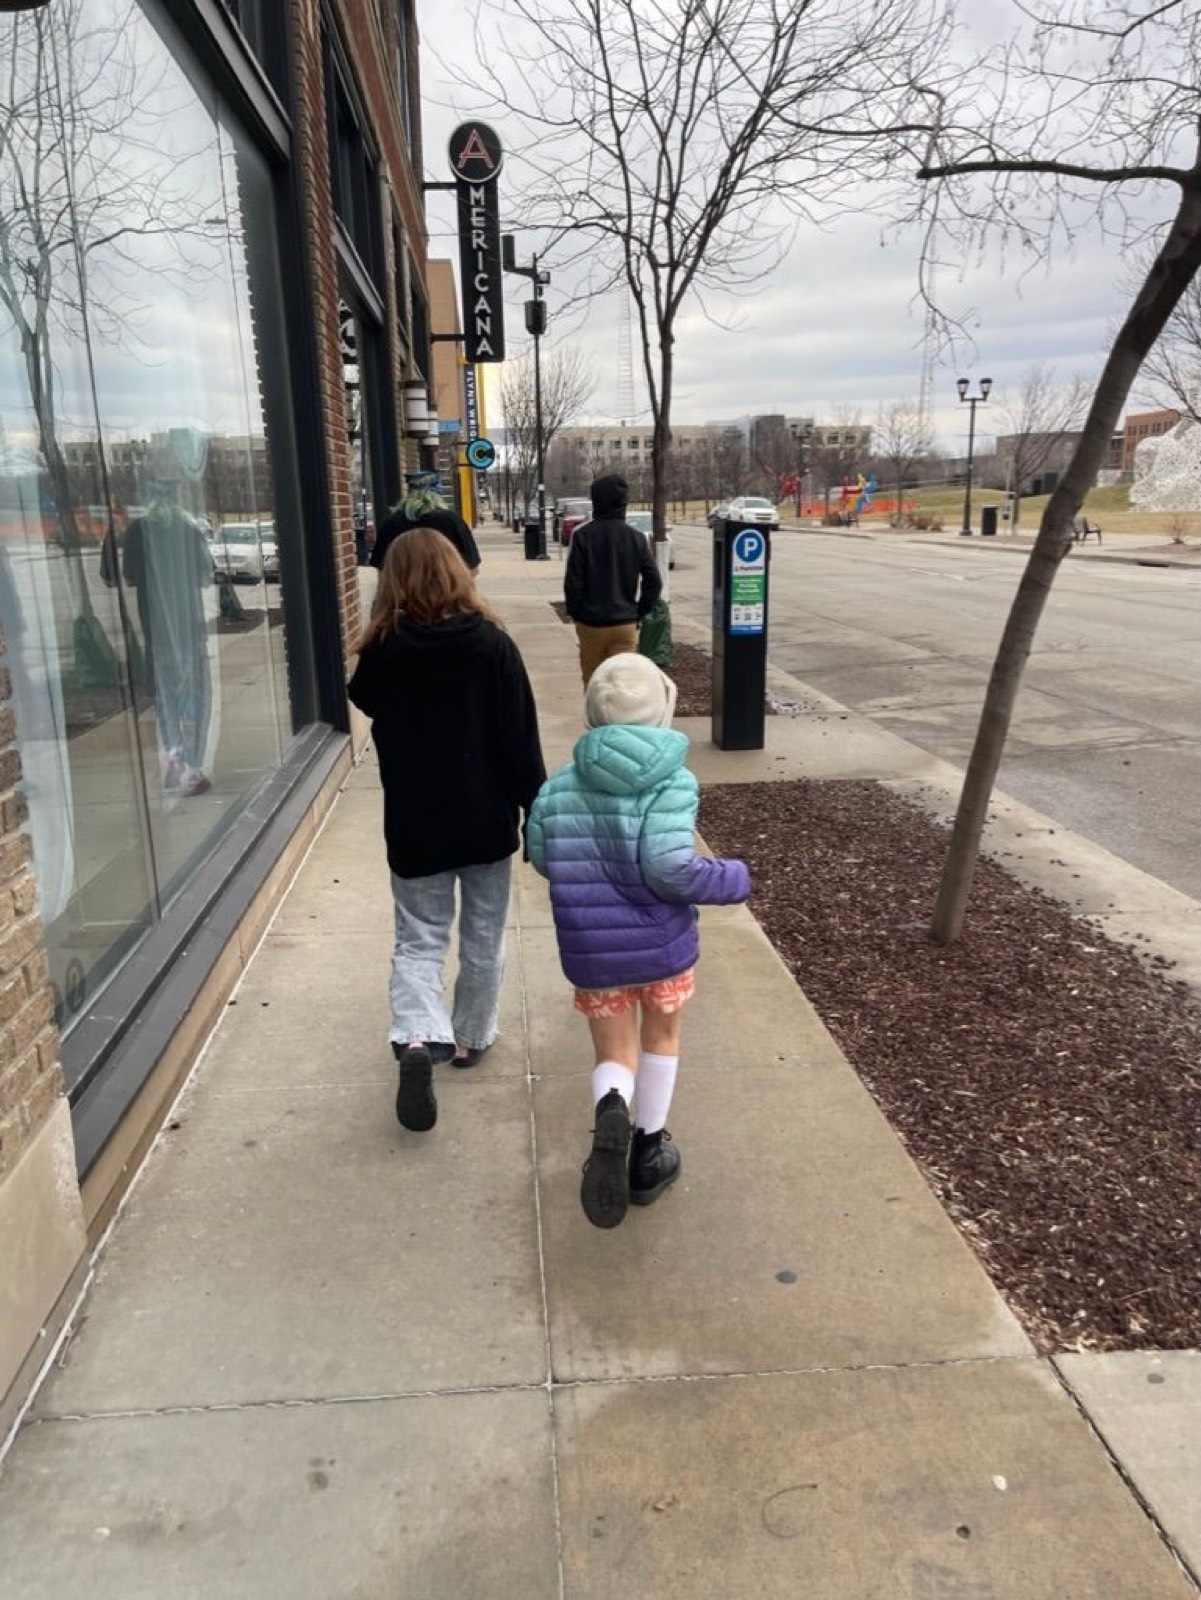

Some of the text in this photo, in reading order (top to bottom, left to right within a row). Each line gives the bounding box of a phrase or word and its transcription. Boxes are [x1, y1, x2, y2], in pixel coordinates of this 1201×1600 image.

[457, 129, 494, 356] AMERICANA
[469, 441, 492, 467] C
[744, 538, 758, 558] P
